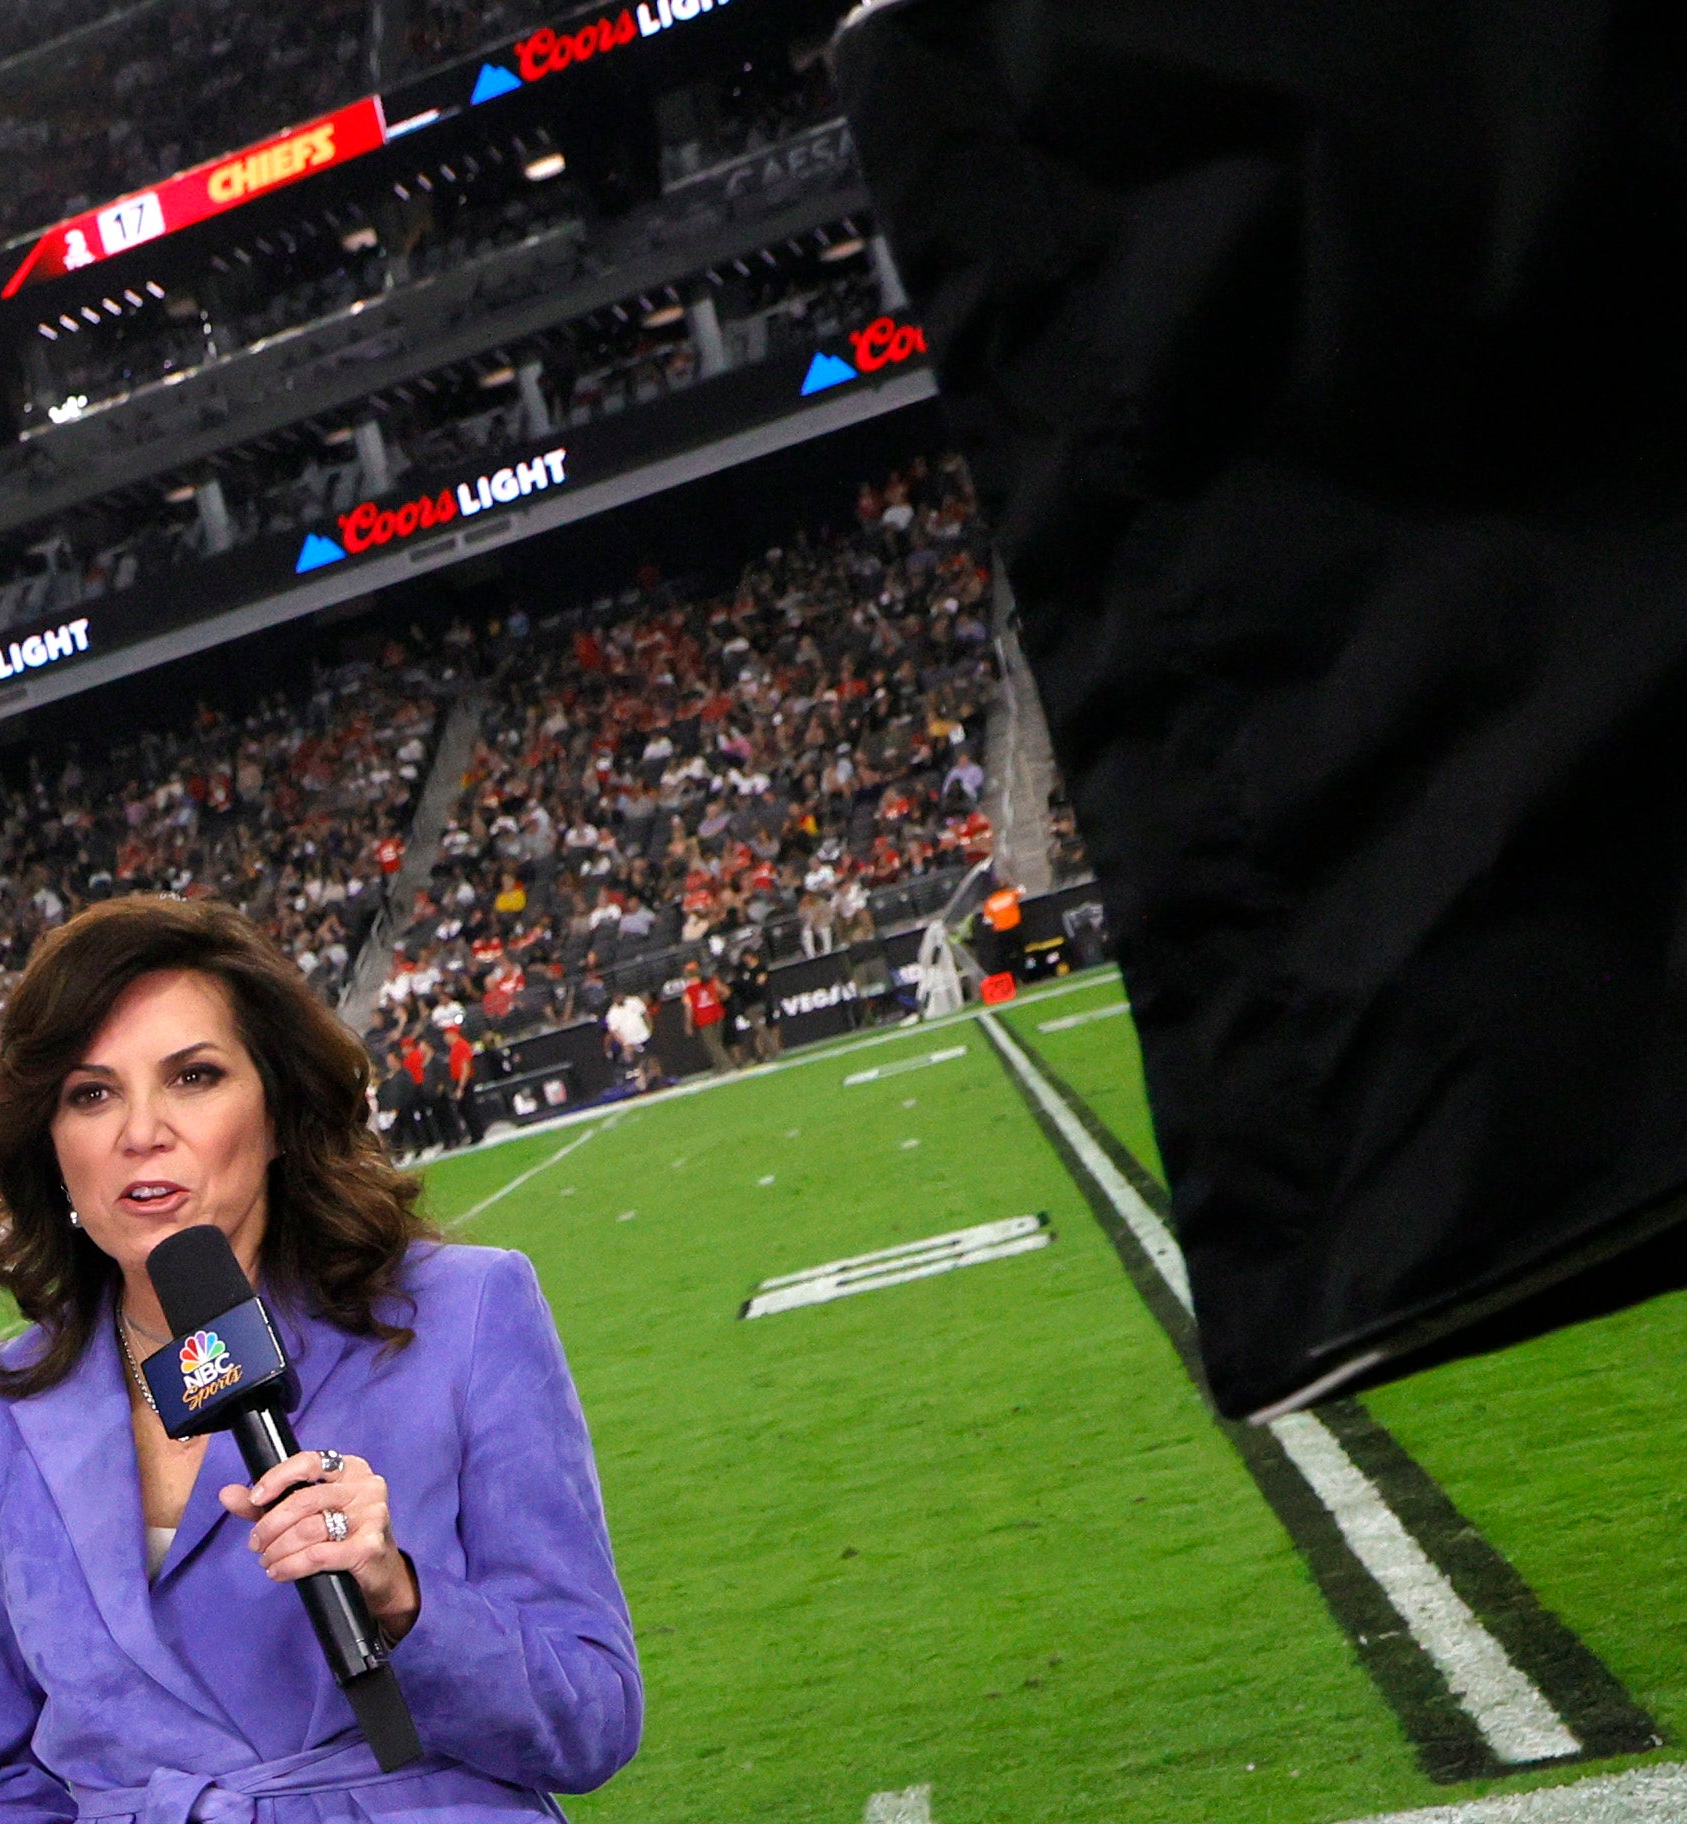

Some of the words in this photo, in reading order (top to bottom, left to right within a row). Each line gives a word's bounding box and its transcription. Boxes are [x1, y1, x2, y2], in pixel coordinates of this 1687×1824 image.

[514, 9, 638, 82] Coors
[113, 203, 144, 240] 17
[208, 124, 336, 203] CHIEFS
[337, 488, 458, 555] Coors
[457, 448, 567, 517] LIGHT
[182, 1364, 243, 1411] Sports
[183, 1352, 234, 1390] NBC
